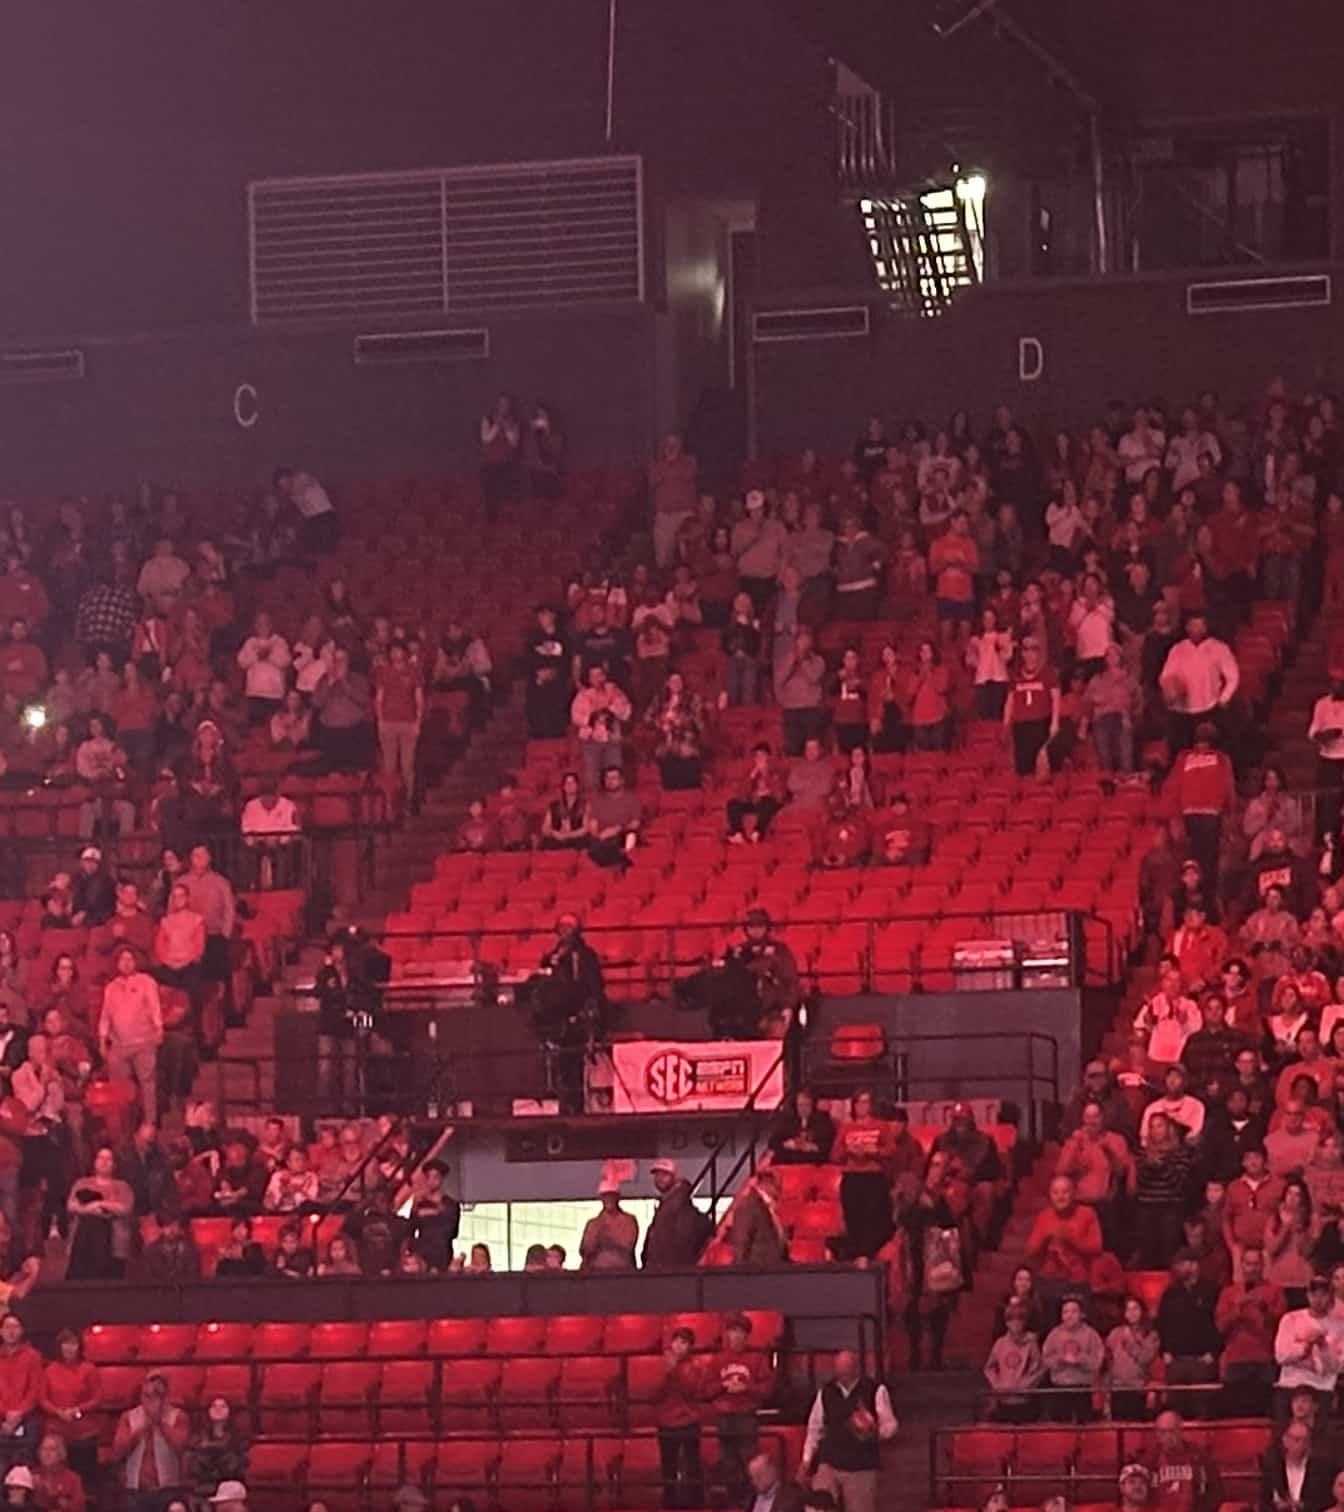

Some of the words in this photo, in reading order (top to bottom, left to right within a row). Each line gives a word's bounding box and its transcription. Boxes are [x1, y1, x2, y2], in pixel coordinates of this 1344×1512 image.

[1019, 337, 1043, 379] D
[233, 383, 258, 426] C
[650, 1056, 694, 1101] SEC
